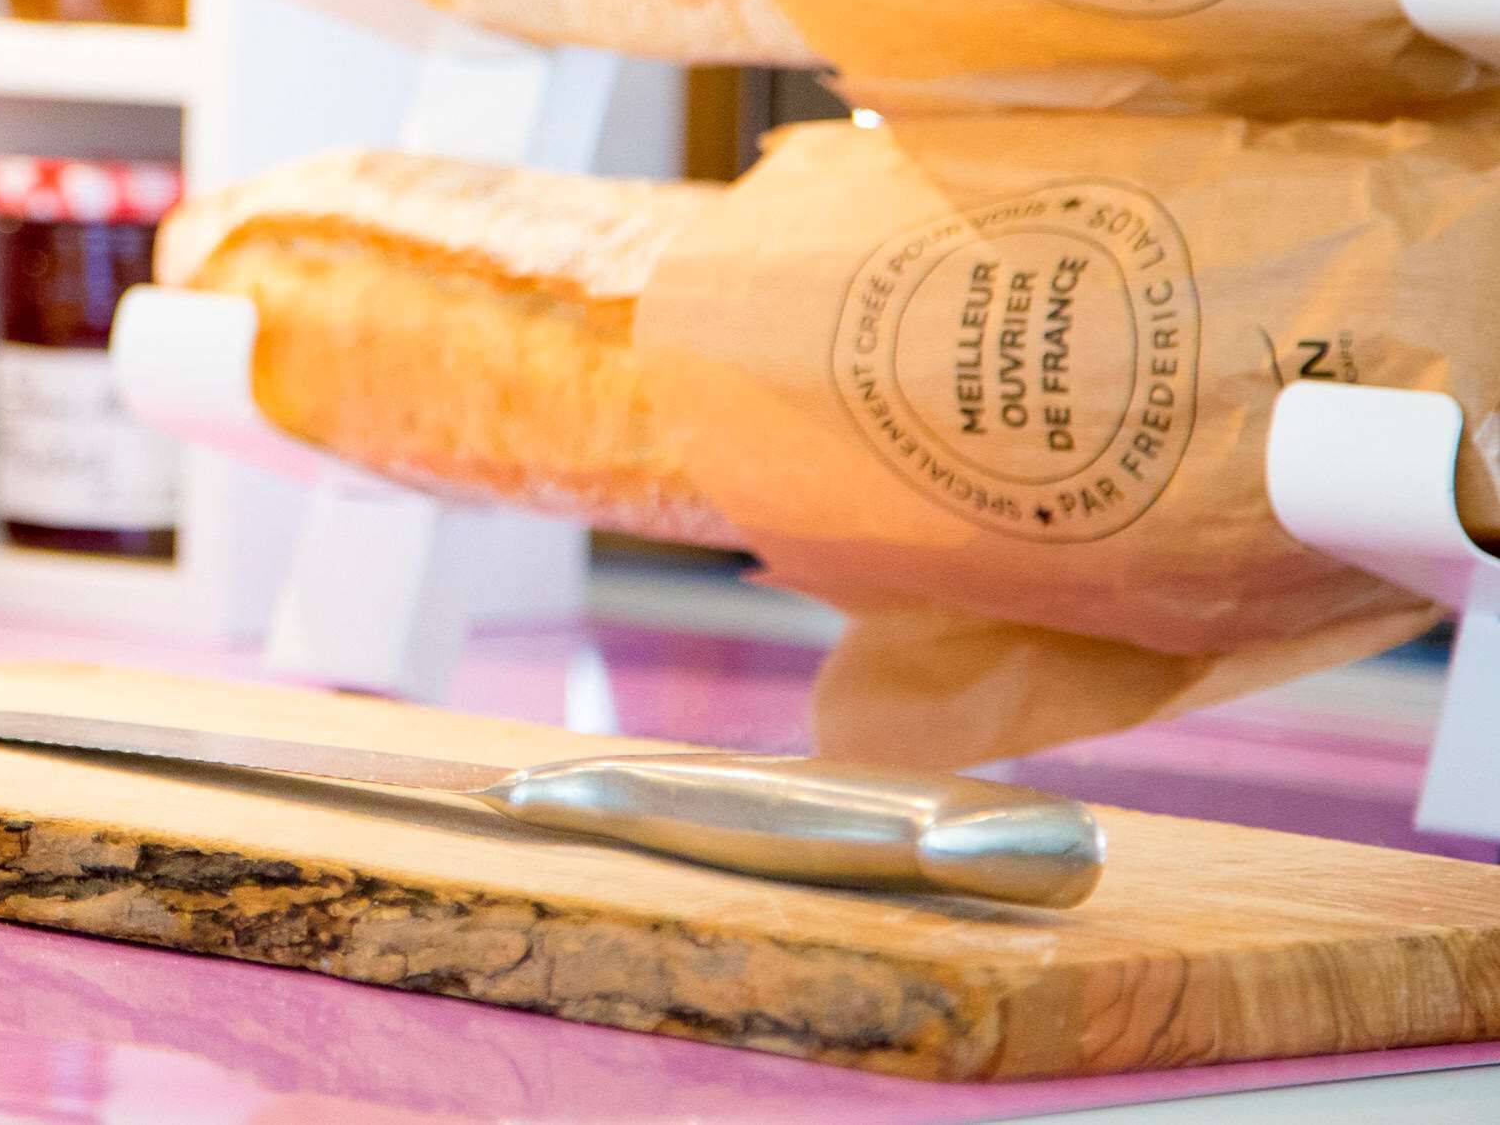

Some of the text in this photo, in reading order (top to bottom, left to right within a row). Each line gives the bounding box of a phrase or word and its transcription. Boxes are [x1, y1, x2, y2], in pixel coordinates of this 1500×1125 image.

[956, 260, 1000, 436] MEILLEUR
[1000, 271, 1039, 428] OUVRIER
[1042, 254, 1089, 453] DE FRANCE
[1058, 203, 1180, 519] PAR FREDERIC LALOS
